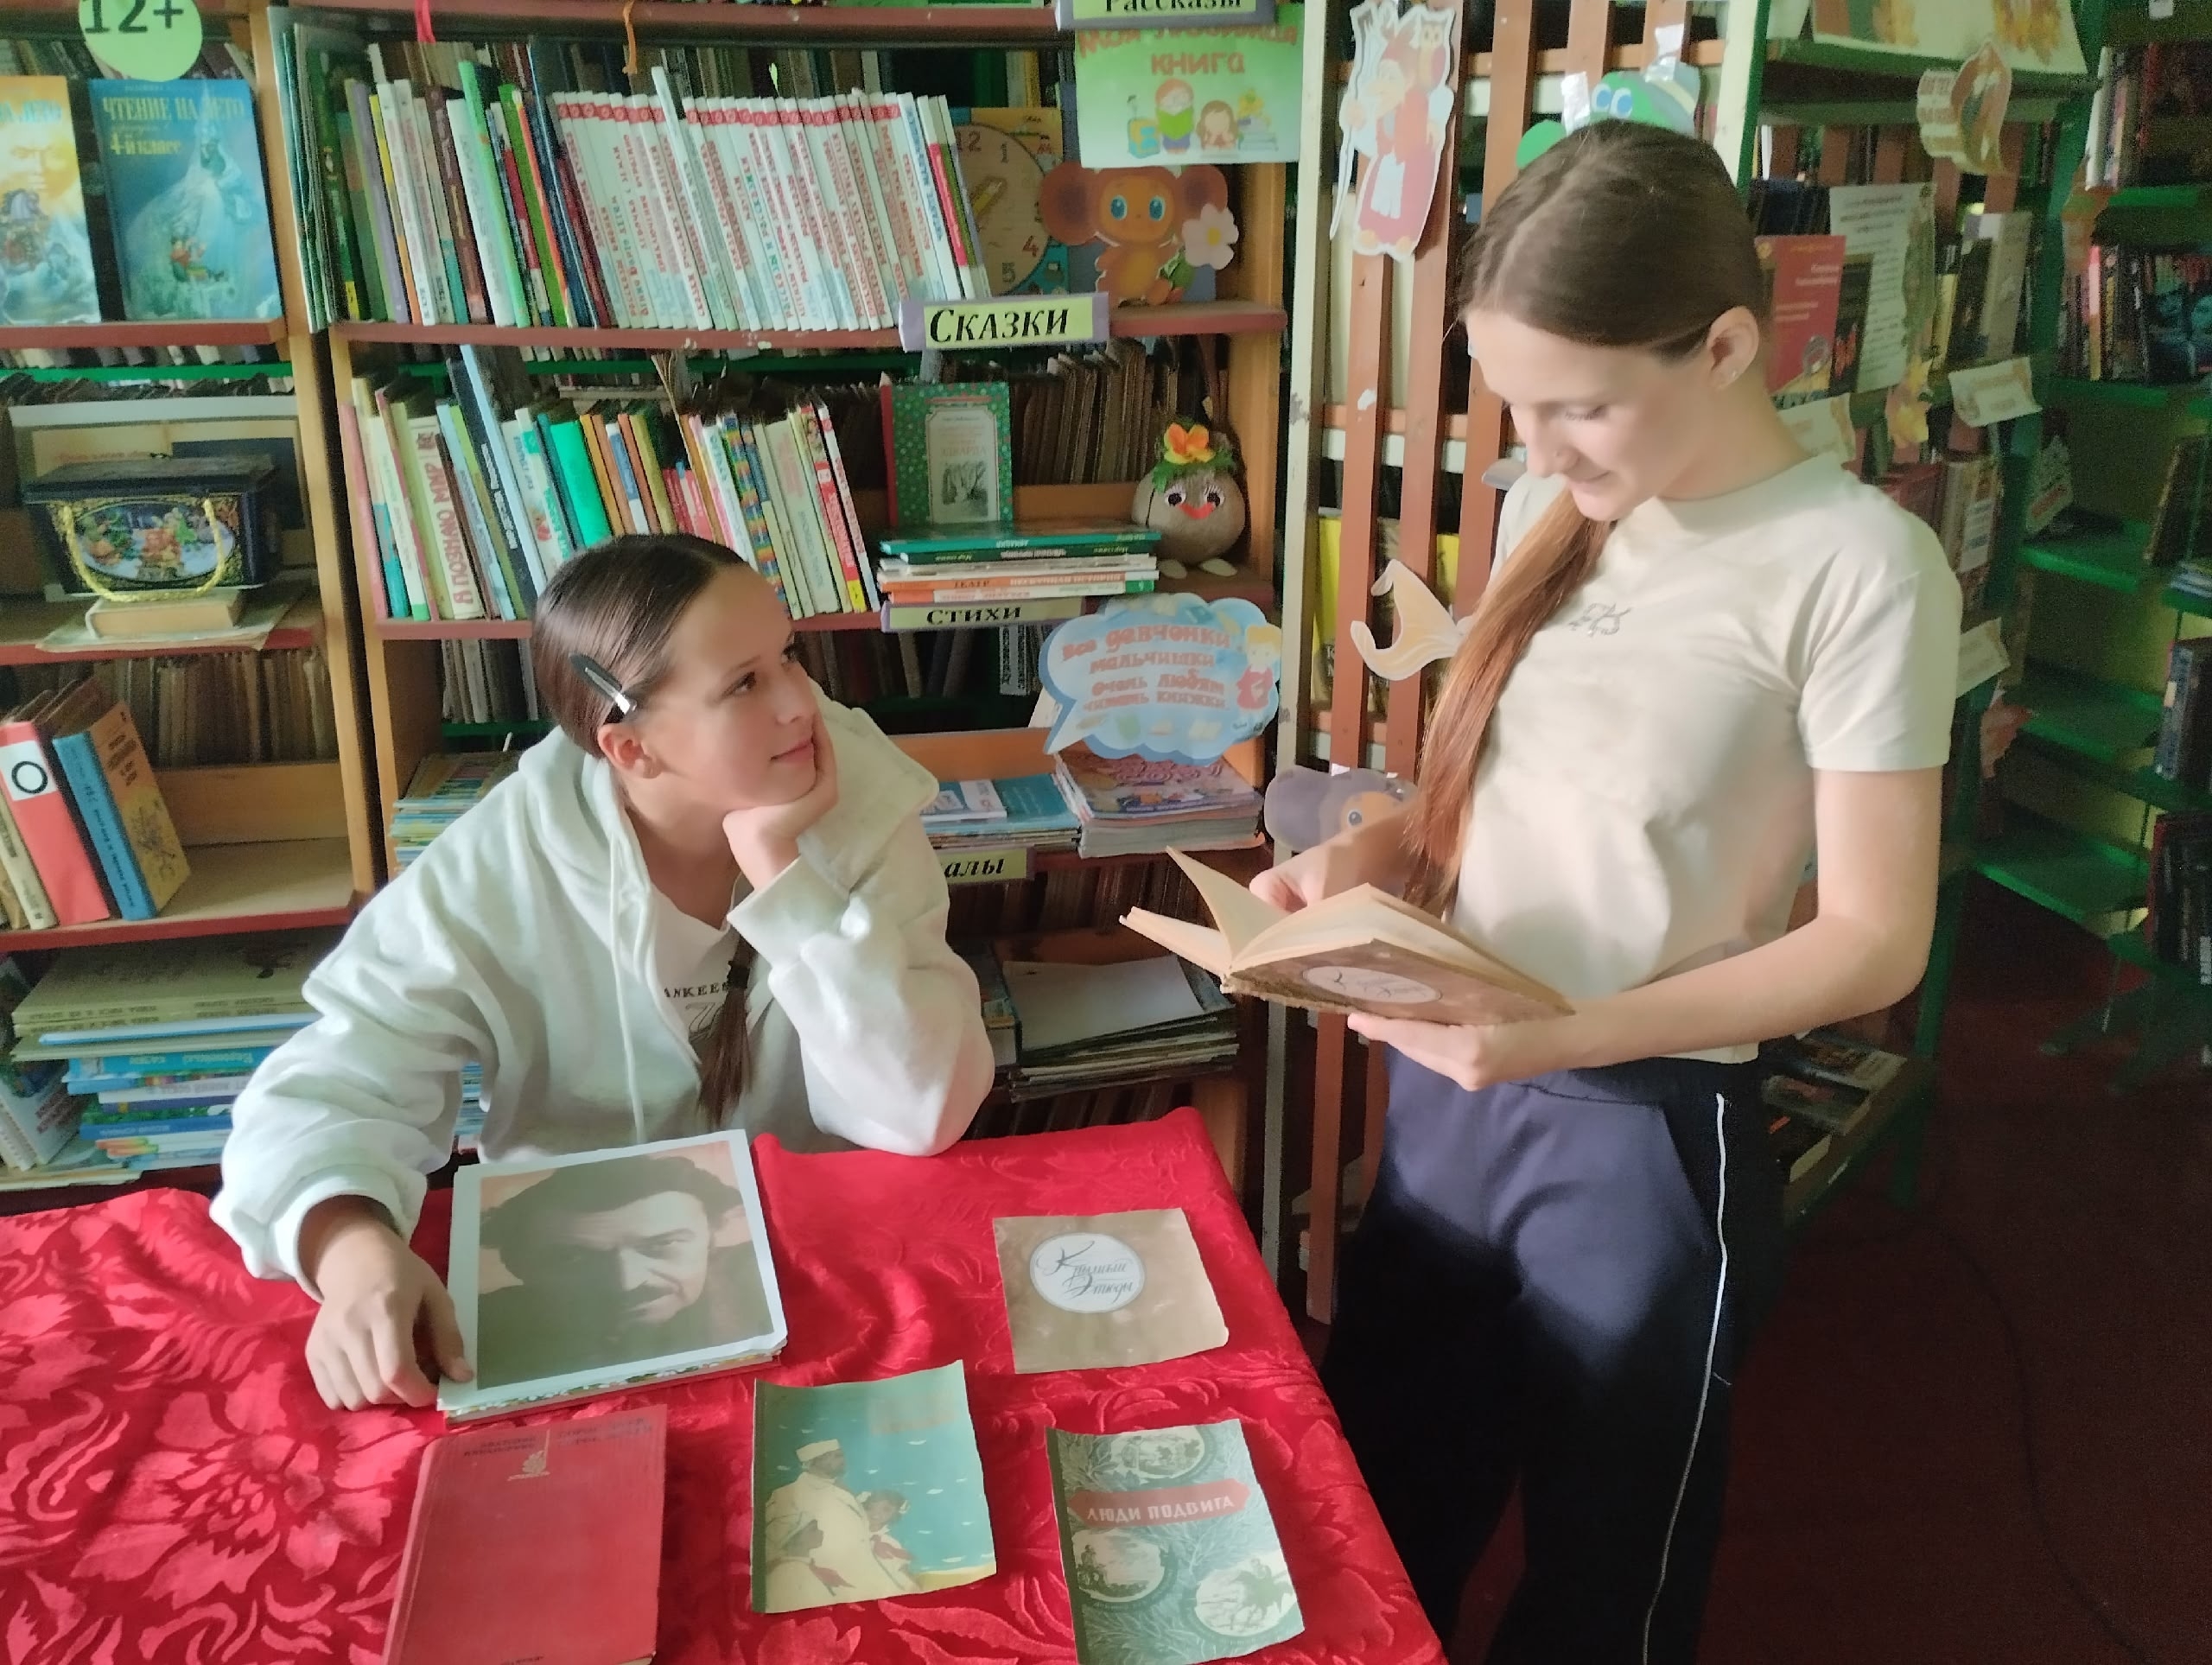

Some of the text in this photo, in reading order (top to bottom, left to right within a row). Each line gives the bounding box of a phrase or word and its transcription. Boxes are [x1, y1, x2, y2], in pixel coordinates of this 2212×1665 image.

[85, 0, 183, 34] 12+
[1152, 52, 1244, 75] книга
[103, 97, 172, 121] ЧТЕНИЕ
[175, 97, 199, 120] НА
[1023, 235, 1039, 257] 4
[421, 463, 474, 607] Я ПОЗНАЮ МИР
[1106, 624, 1230, 652] девчонки
[944, 858, 1005, 879] алы
[1087, 1496, 1234, 1524] ЛЮДИ ПОДВИГА
